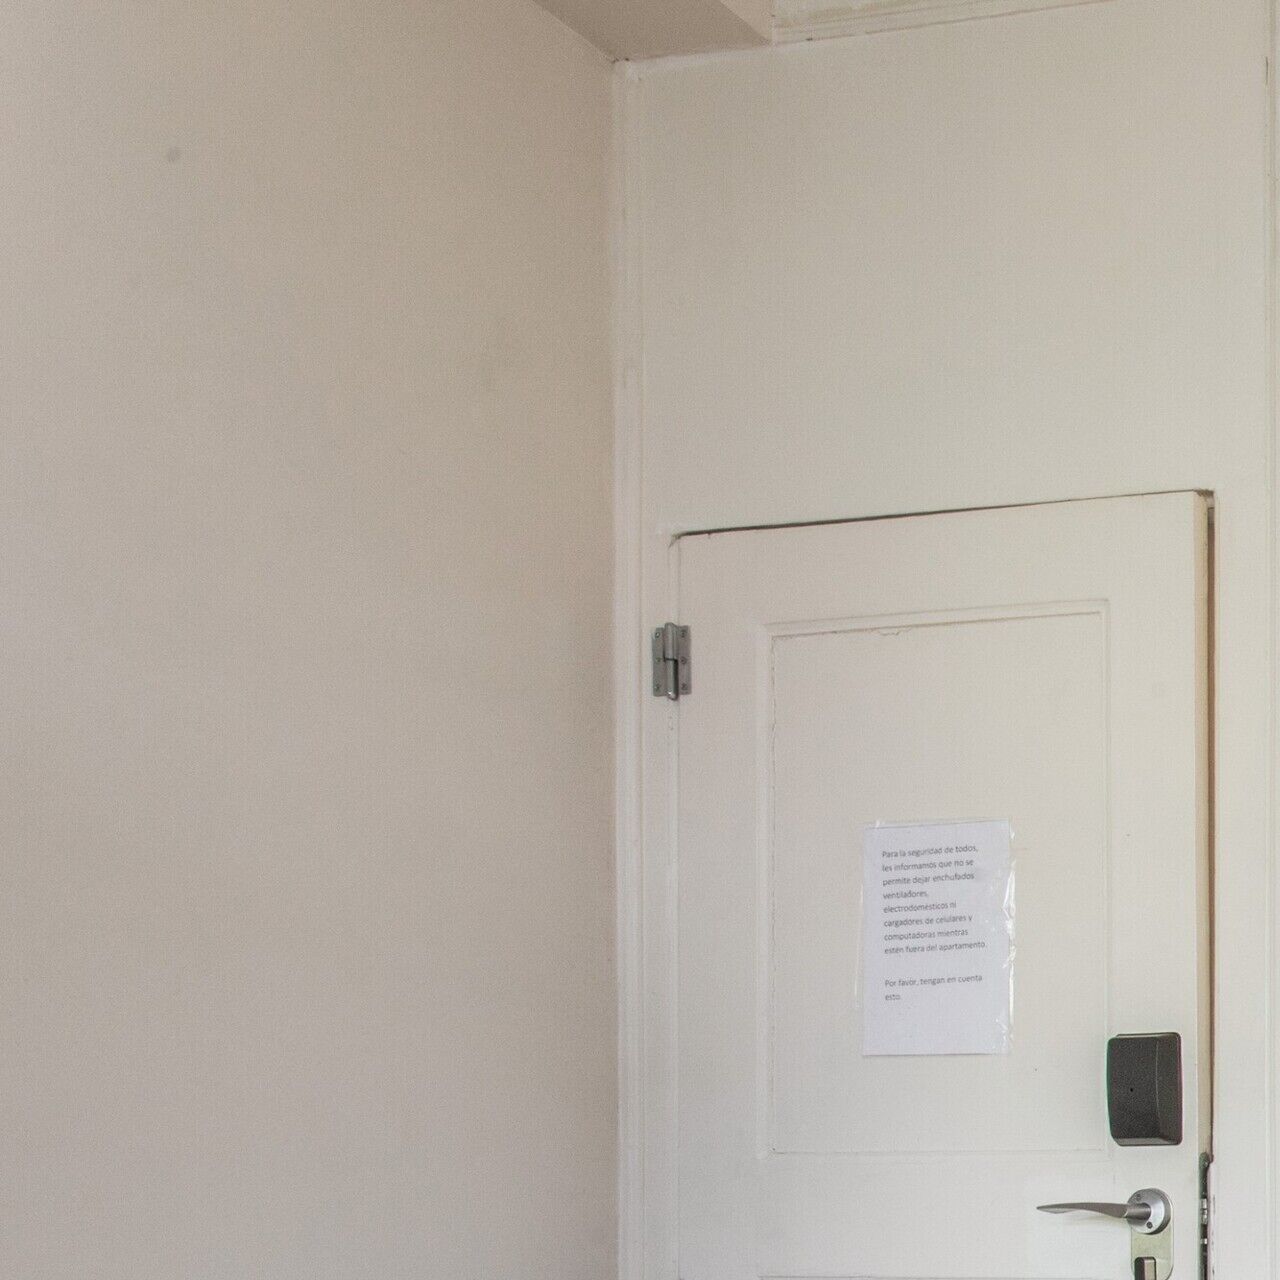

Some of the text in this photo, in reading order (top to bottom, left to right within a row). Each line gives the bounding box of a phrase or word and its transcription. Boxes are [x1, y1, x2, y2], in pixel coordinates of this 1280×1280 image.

[907, 847, 942, 857] seguridad
[944, 846, 954, 854] de
[882, 864, 892, 872] les
[894, 862, 937, 871] informamos
[938, 861, 952, 869] que
[882, 872, 975, 887] permite dejar enchufados
[949, 901, 957, 909] ni
[883, 918, 924, 928] cargadores
[924, 917, 934, 925] de
[935, 915, 967, 924] celulares
[883, 929, 968, 941] computadoras mientras
[905, 945, 925, 953] fuera
[926, 944, 937, 952] del
[920, 977, 945, 986] tengan
[957, 975, 982, 983] cuenta
